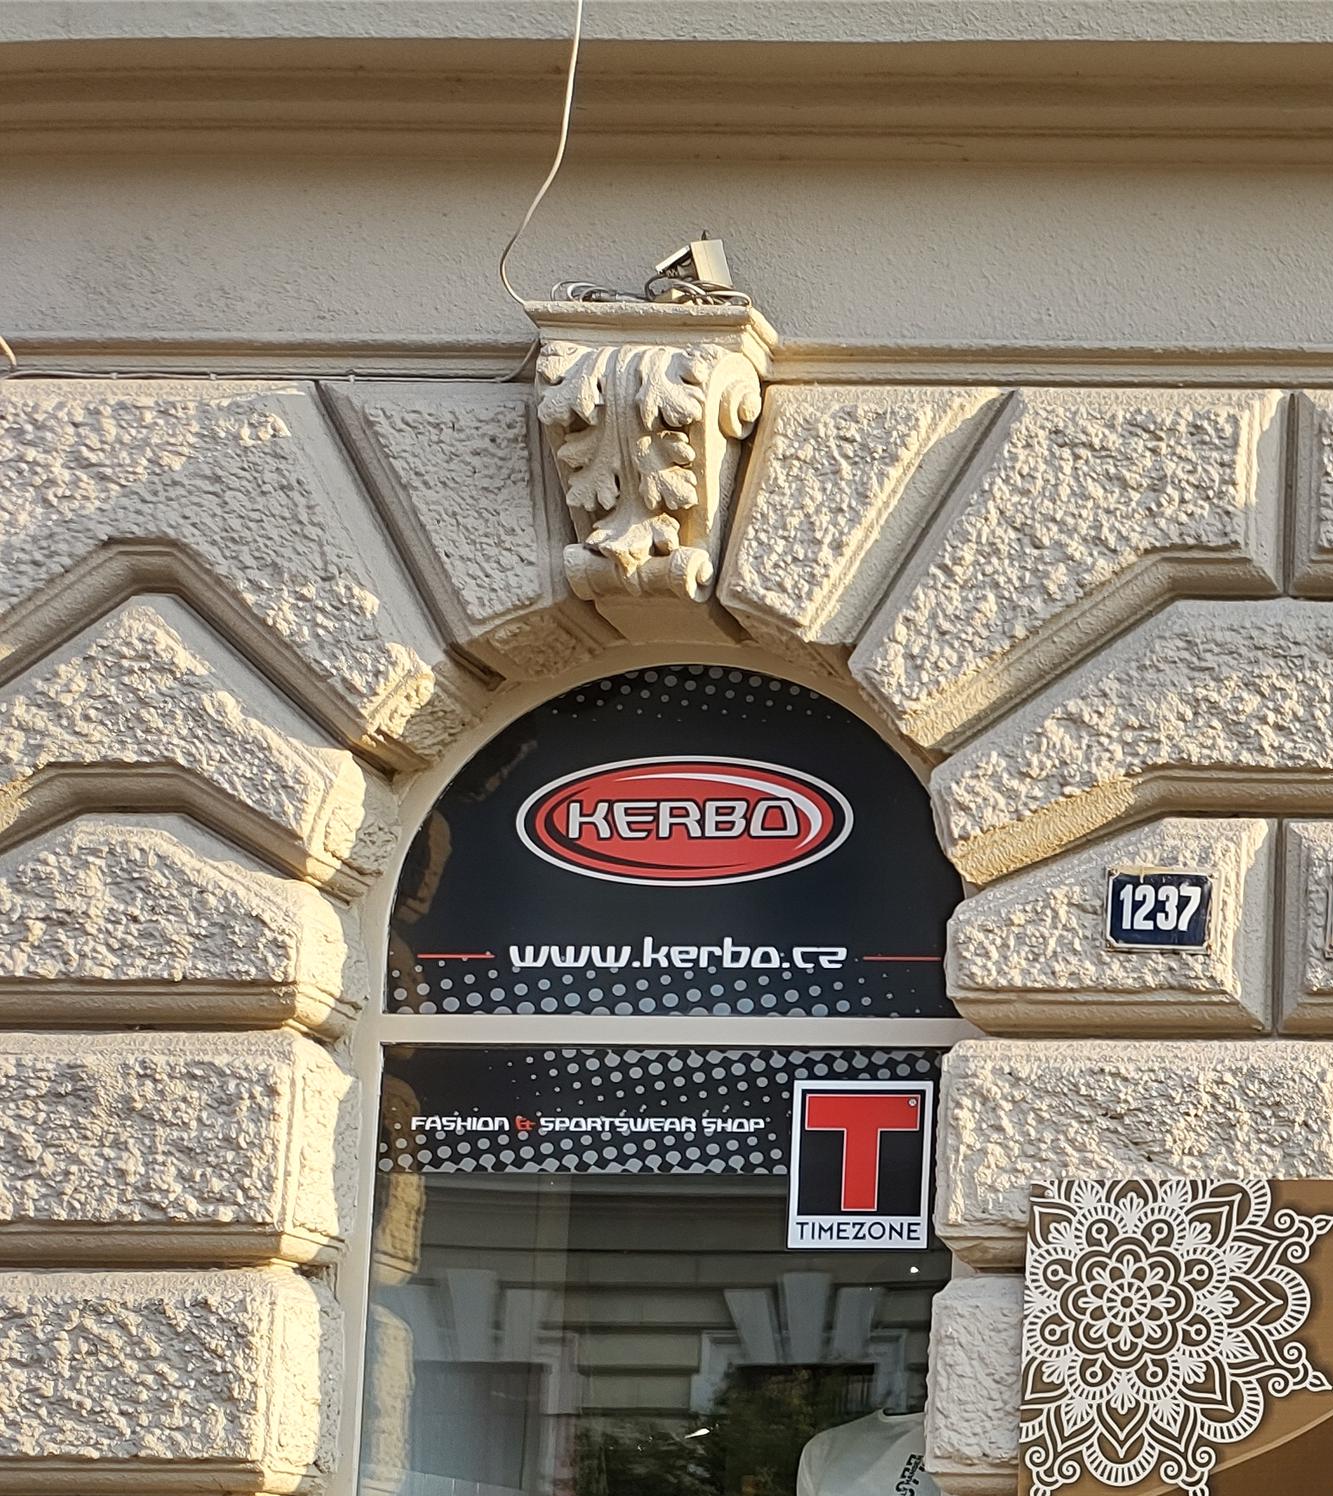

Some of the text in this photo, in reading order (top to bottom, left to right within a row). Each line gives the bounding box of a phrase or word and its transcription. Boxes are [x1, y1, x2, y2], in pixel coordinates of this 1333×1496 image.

[567, 799, 800, 839] KERBO
[1119, 884, 1202, 931] 1237
[508, 936, 848, 970] www.kerbo.cz
[411, 1116, 510, 1132] FASHION
[540, 1116, 697, 1133] SPORTSWEAR
[702, 1117, 765, 1133] SHOP
[796, 1221, 922, 1242] TIMEZONE
